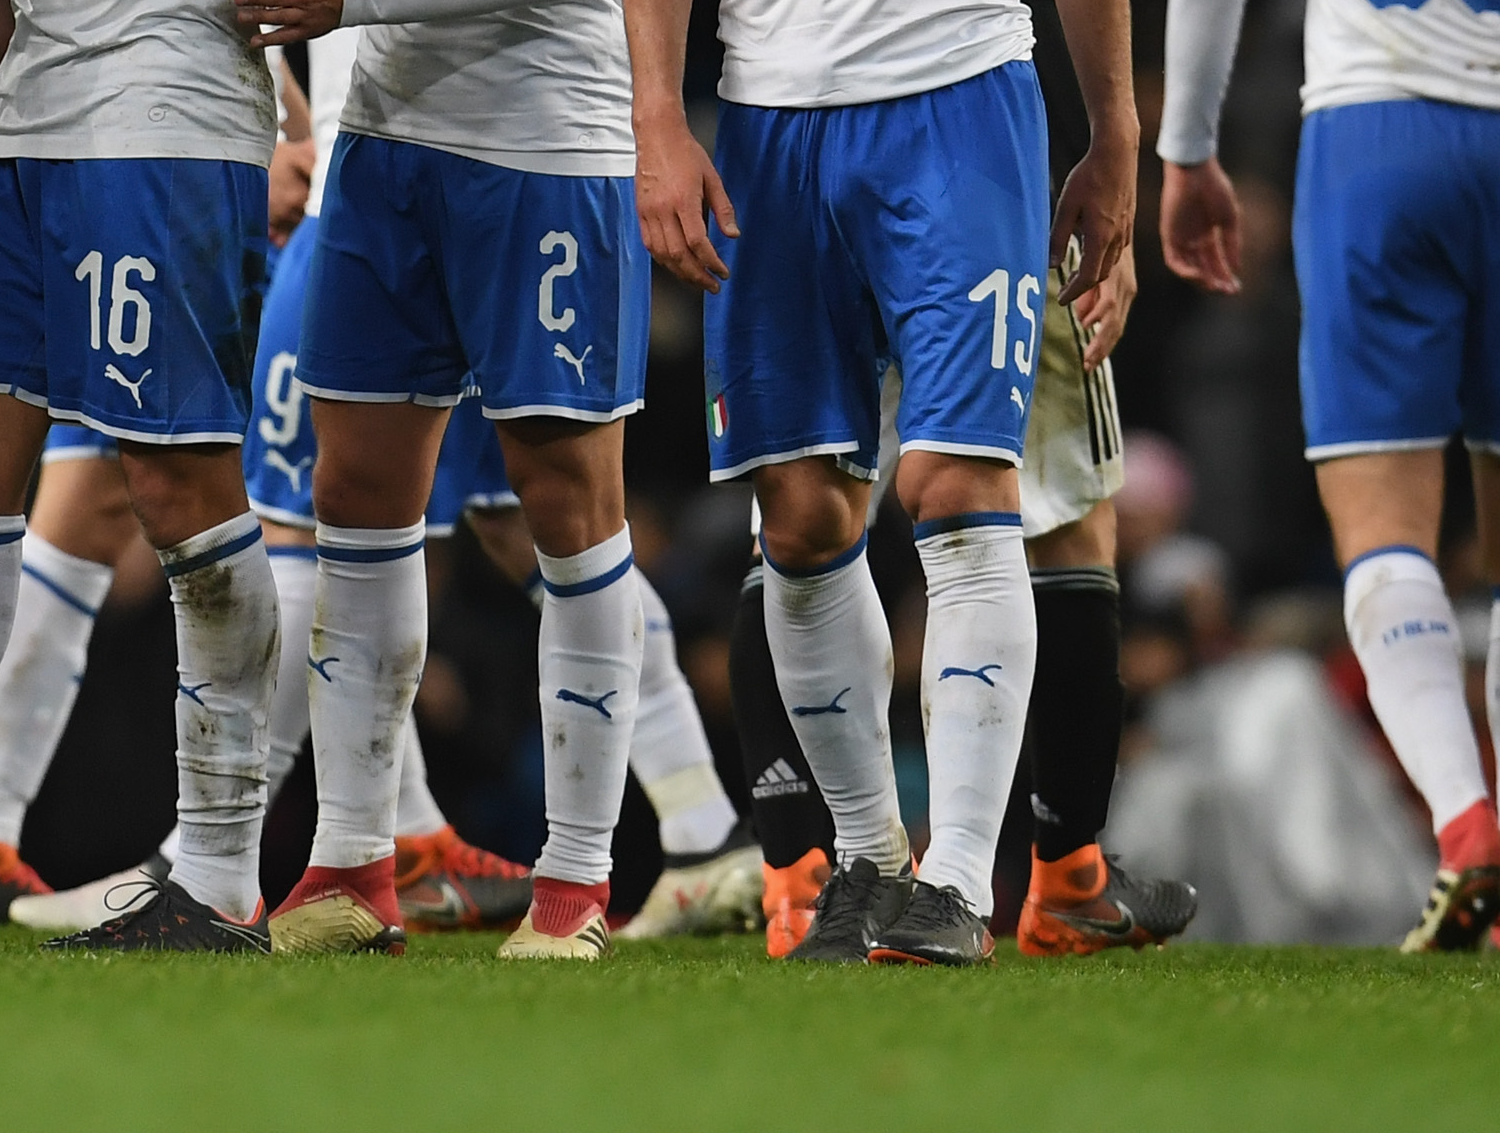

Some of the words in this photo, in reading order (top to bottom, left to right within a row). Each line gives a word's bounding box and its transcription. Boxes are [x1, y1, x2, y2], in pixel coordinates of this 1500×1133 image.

[75, 250, 156, 357] 16
[538, 230, 578, 333] 2
[968, 268, 1041, 377] 15
[258, 350, 304, 447] 9
[752, 780, 809, 799] adidas
